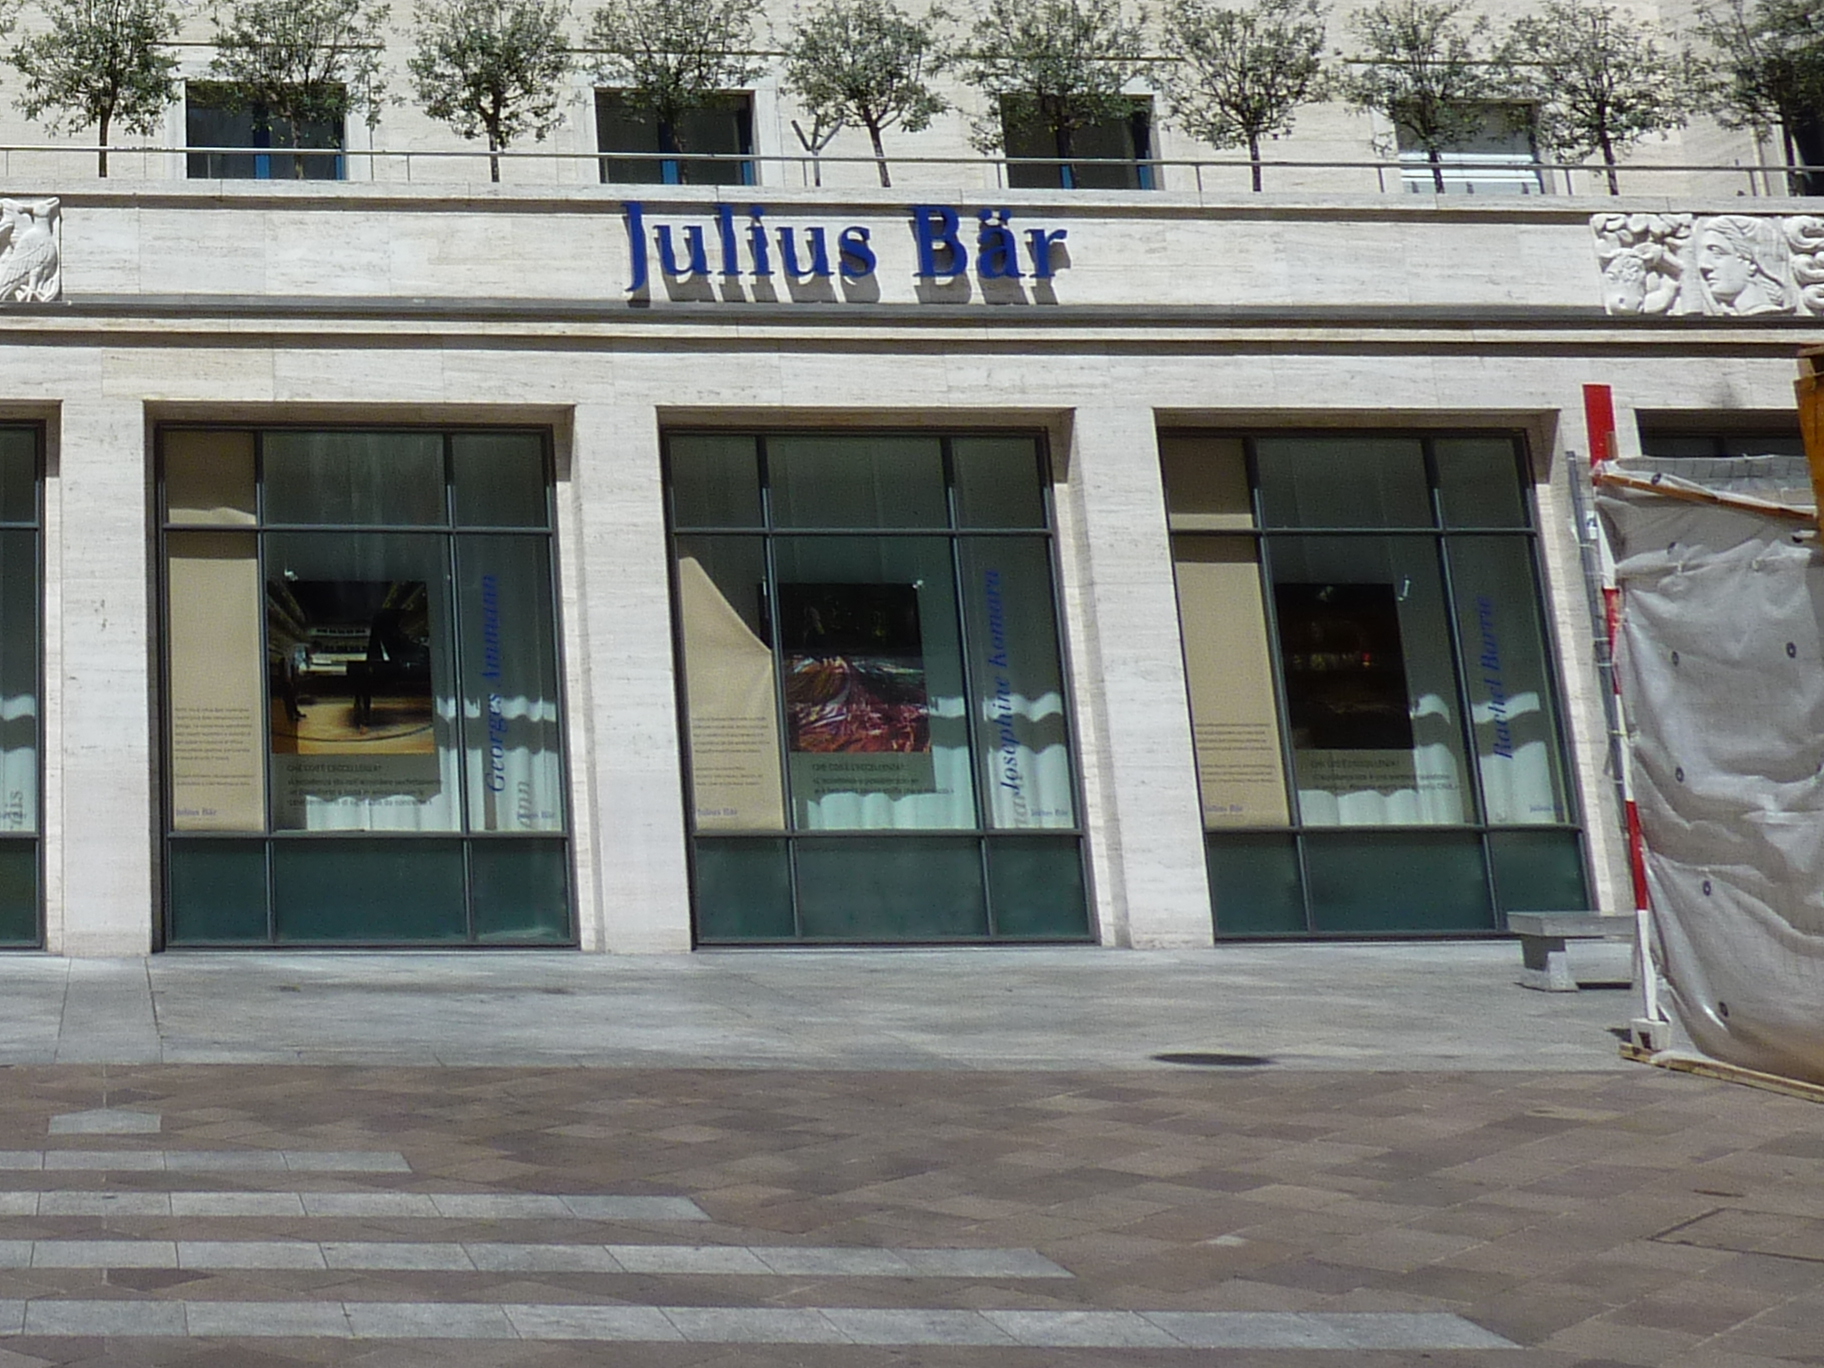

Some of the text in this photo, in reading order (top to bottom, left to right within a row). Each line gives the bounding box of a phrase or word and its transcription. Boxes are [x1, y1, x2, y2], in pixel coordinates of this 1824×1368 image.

[622, 201, 1068, 293] Julius Bär
[486, 693, 509, 793] Georges
[992, 677, 1020, 796] Josephine
[1484, 678, 1513, 759] Rachel
